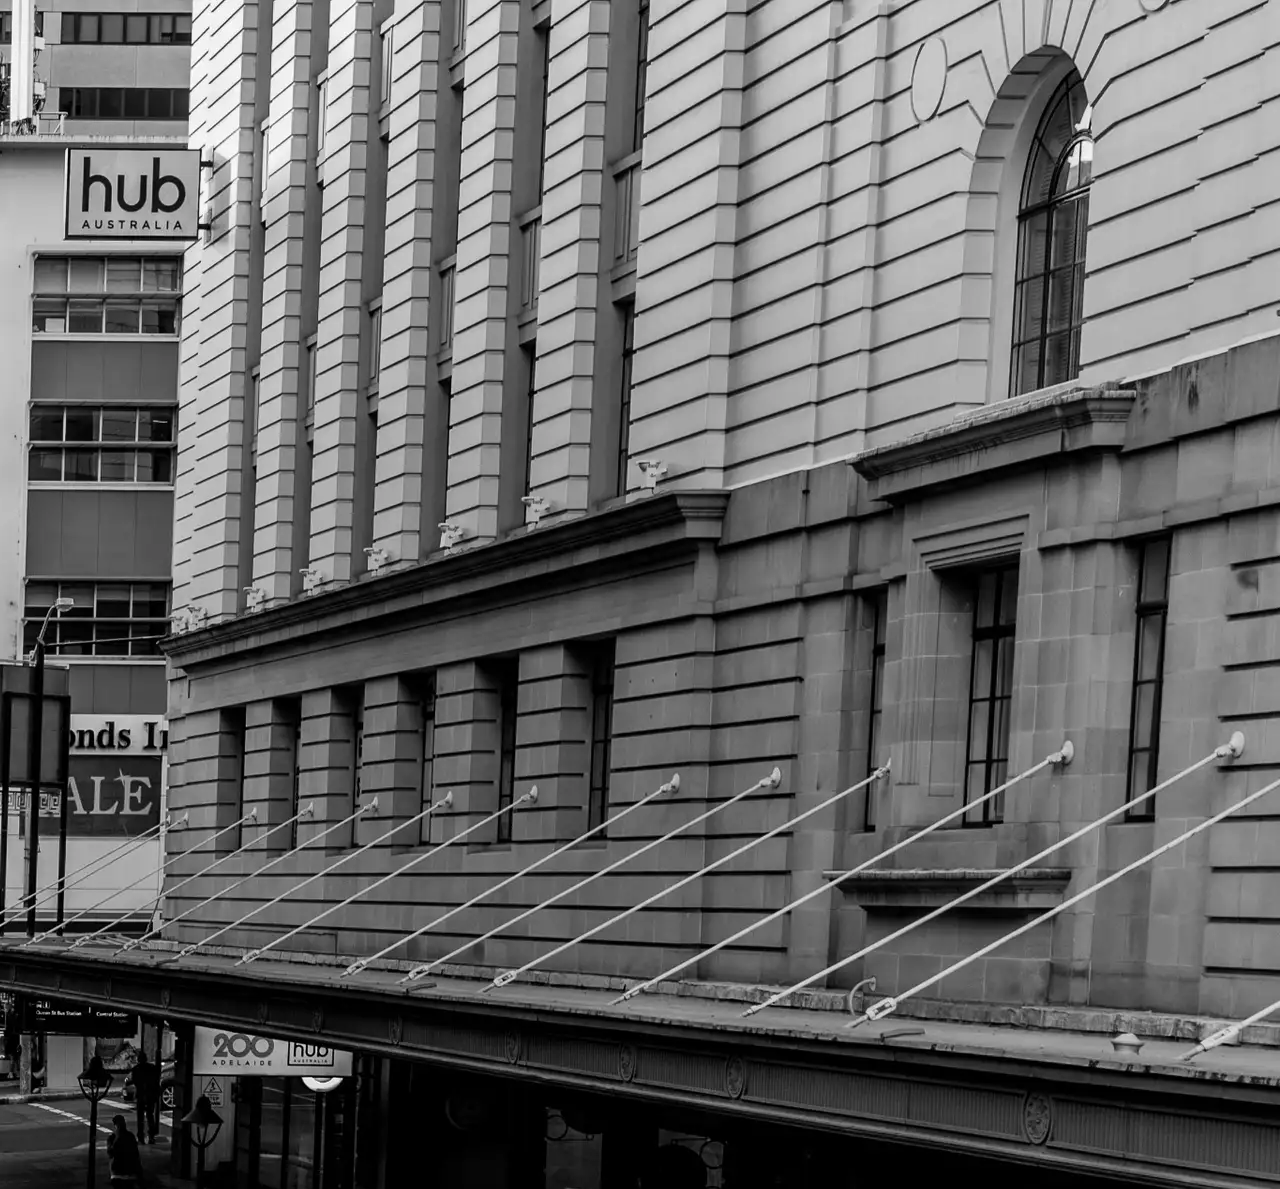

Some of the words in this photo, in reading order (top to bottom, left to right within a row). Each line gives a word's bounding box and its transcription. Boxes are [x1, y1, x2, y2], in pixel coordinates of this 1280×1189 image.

[82, 157, 186, 213] hub
[81, 219, 182, 230] AUSTRALIA
[67, 775, 153, 816] ALE
[213, 1033, 275, 1059] 200
